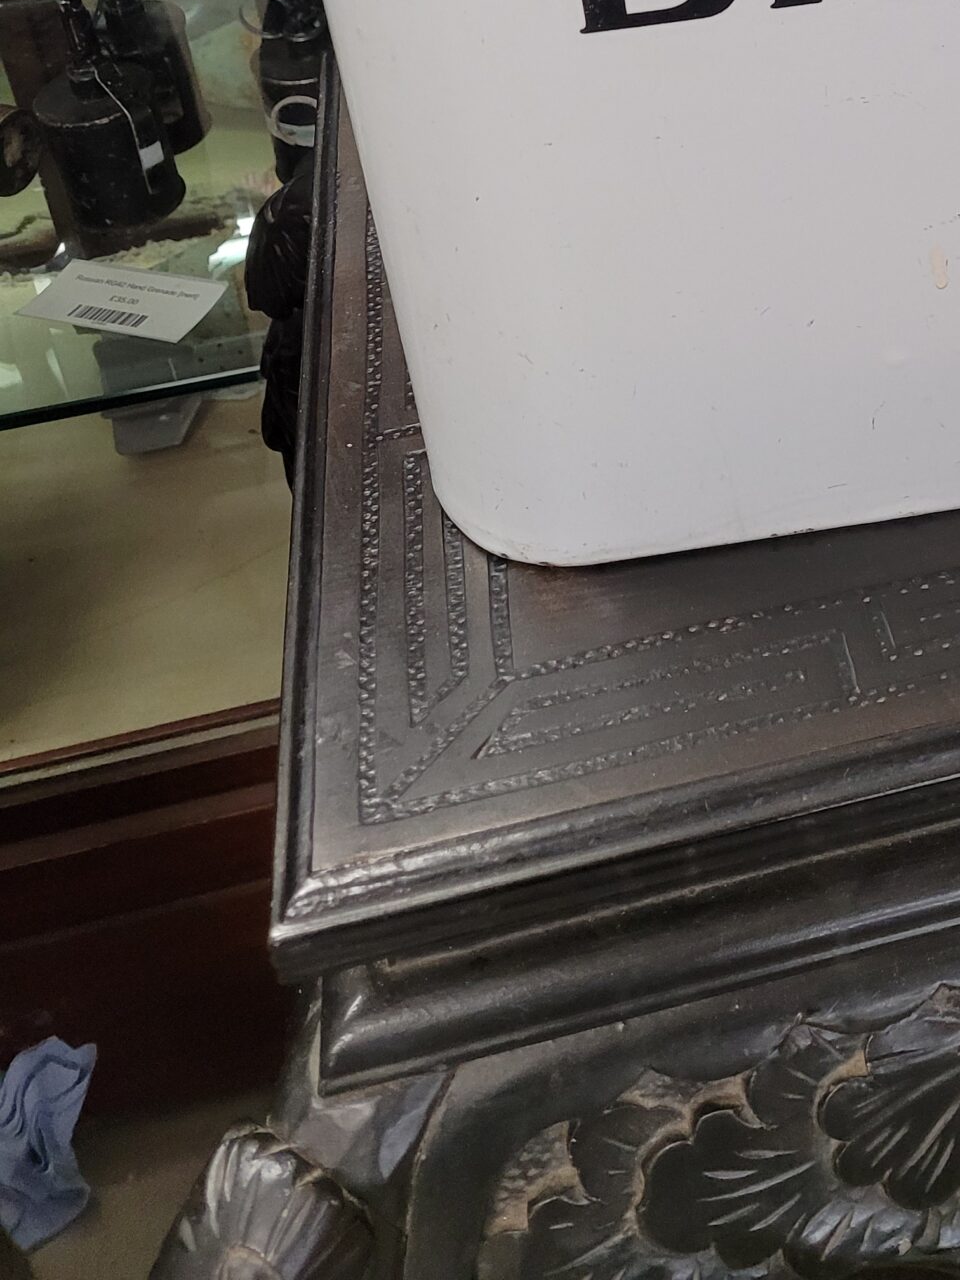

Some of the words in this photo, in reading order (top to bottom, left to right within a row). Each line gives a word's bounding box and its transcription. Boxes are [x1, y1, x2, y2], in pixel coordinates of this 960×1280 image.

[127, 283, 147, 291] Hand
[147, 286, 178, 296] Grenade
[109, 295, 140, 305] £35.00
